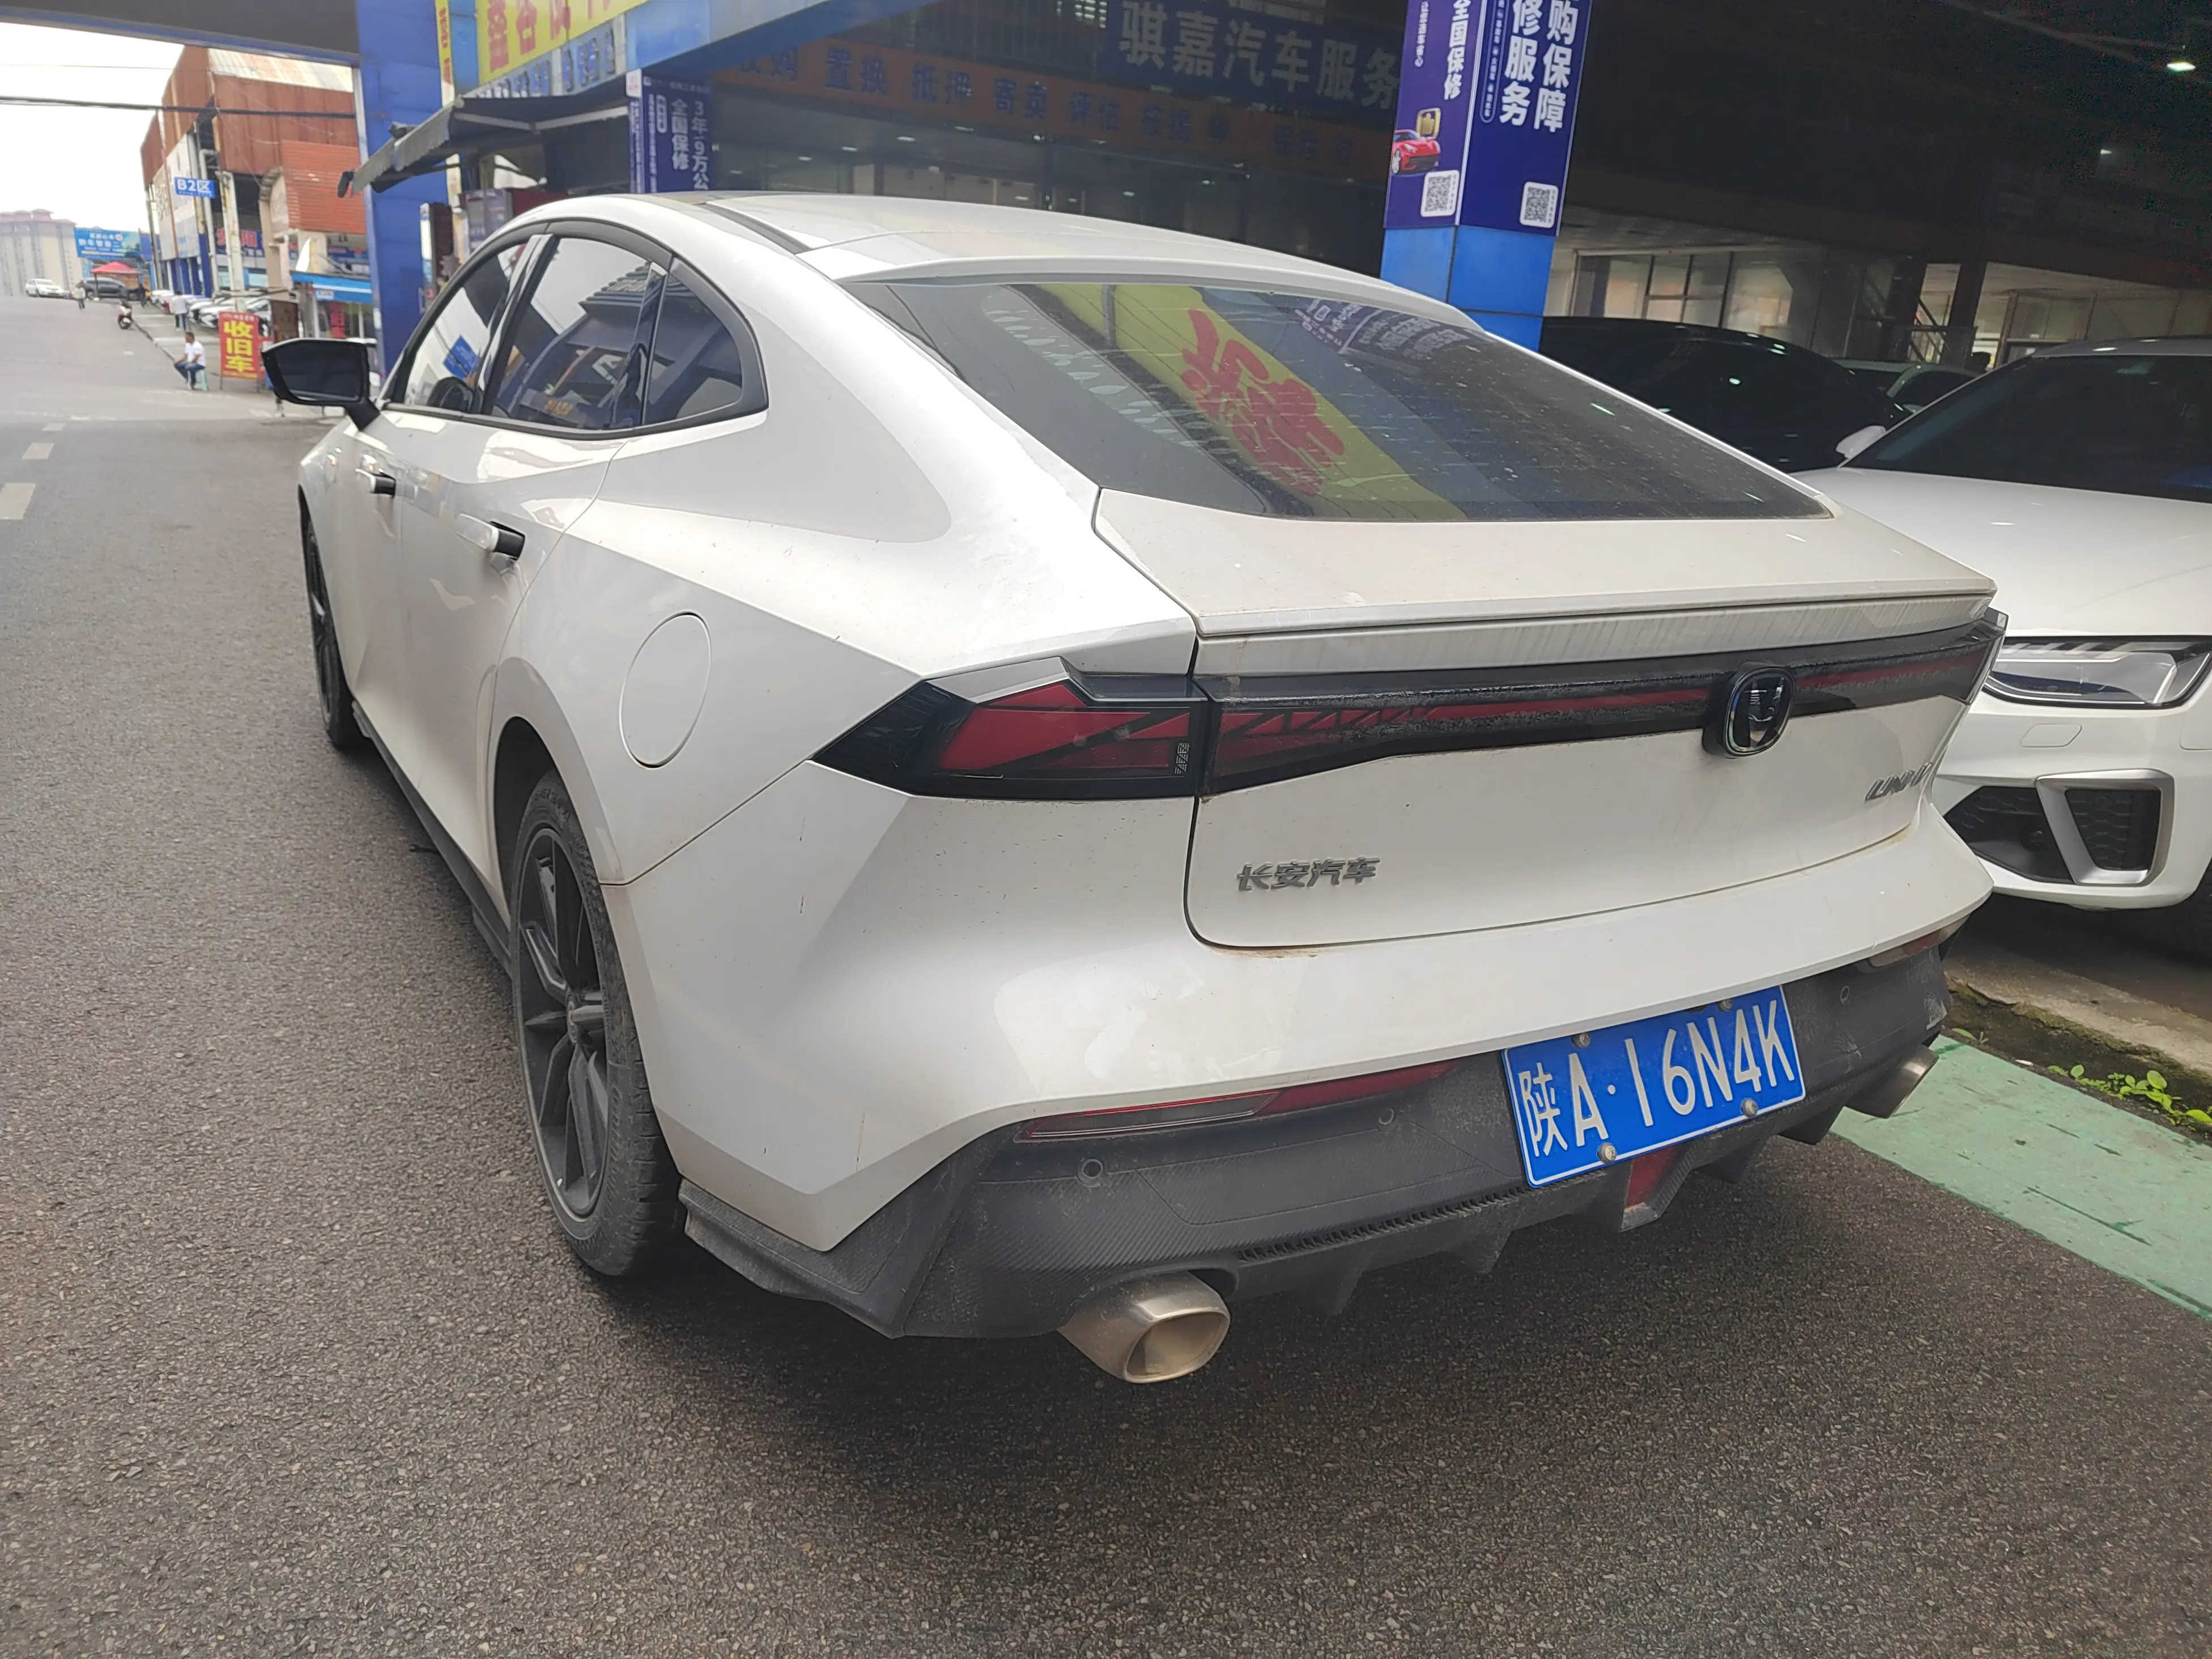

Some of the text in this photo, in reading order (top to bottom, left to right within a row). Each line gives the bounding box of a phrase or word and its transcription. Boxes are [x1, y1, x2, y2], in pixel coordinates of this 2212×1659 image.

[1119, 1, 1400, 110] 骐嘉汽车服务
[177, 178, 211, 194] B2区
[224, 320, 254, 372] 收旧车
[1237, 856, 1381, 892] 长安汽车
